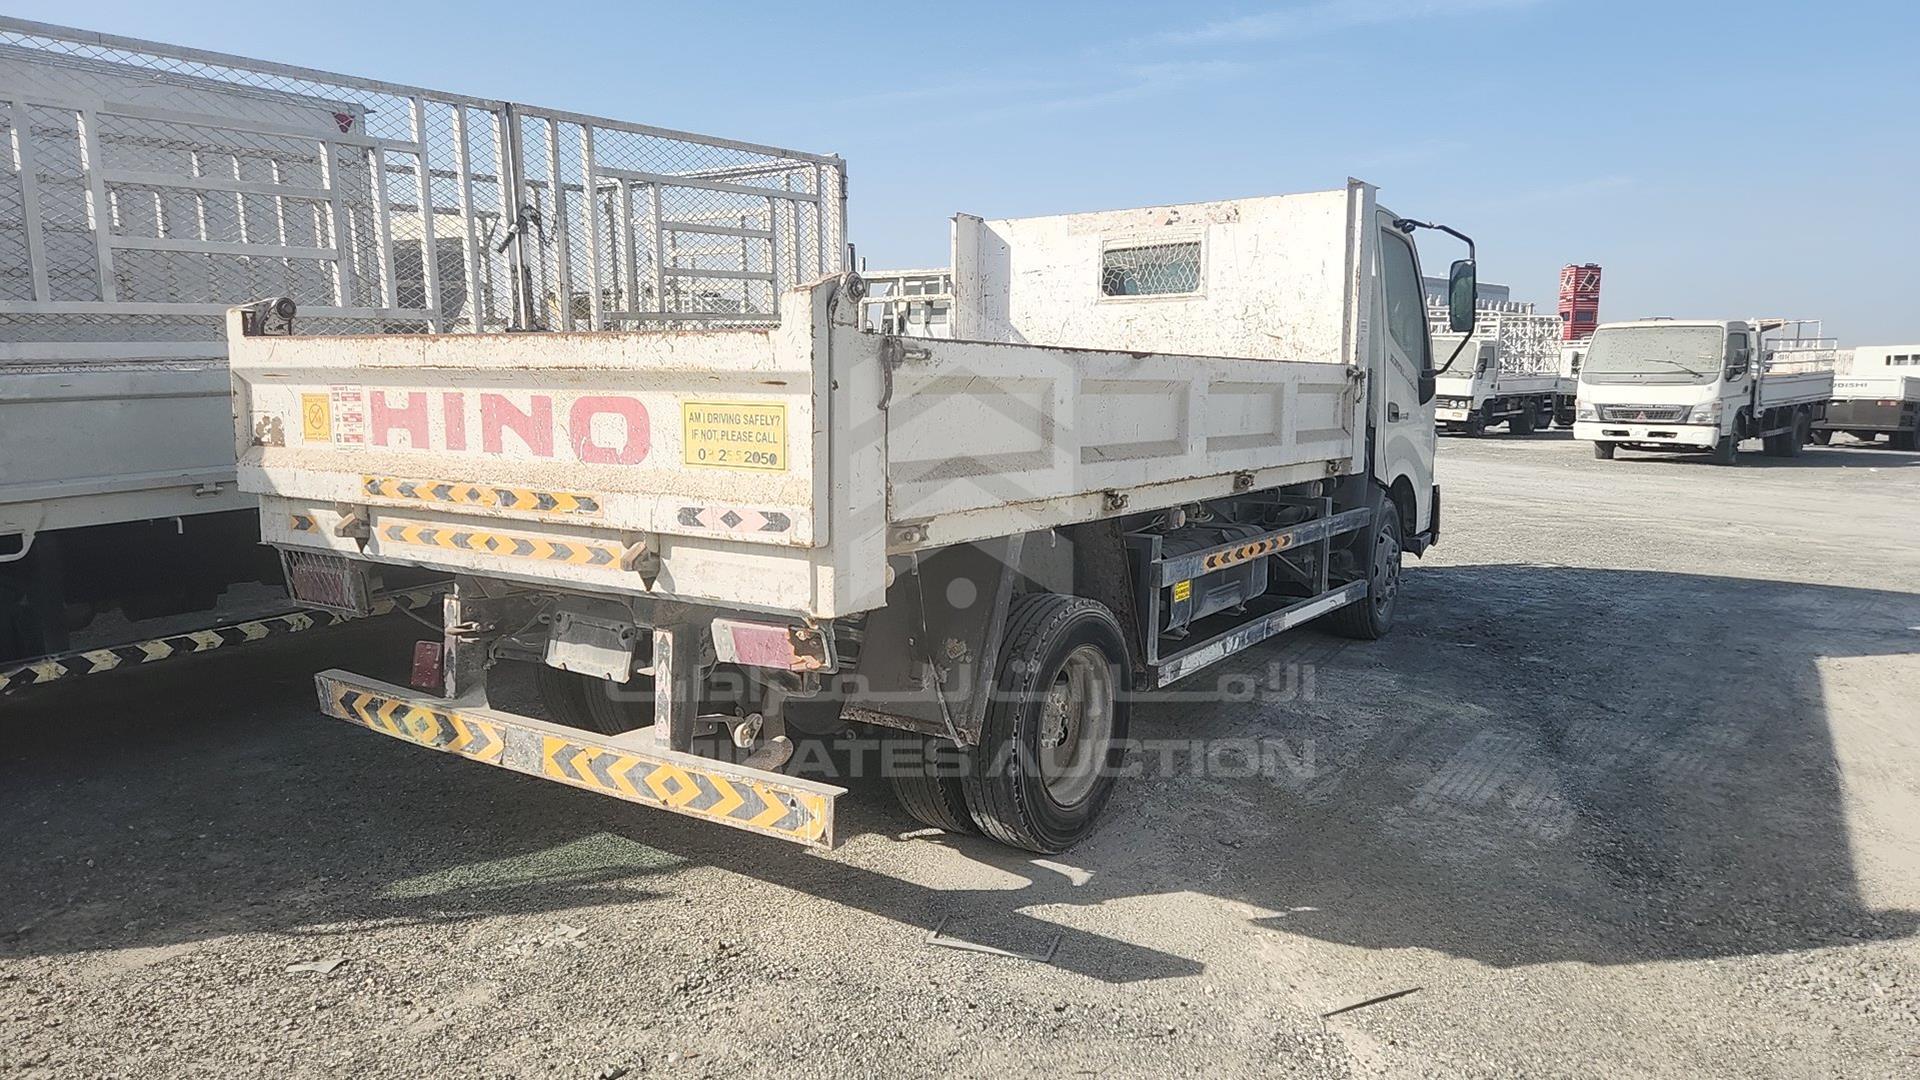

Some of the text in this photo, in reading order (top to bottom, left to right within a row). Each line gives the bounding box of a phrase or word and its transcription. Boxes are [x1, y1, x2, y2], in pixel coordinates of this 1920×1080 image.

[688, 411, 701, 423] AM
[707, 412, 741, 425] DRIVING
[743, 414, 781, 426] SAFELY?
[369, 390, 651, 466] HINO
[691, 429, 699, 440] IF
[720, 430, 753, 442] PLEASE
[755, 431, 778, 444] CALL
